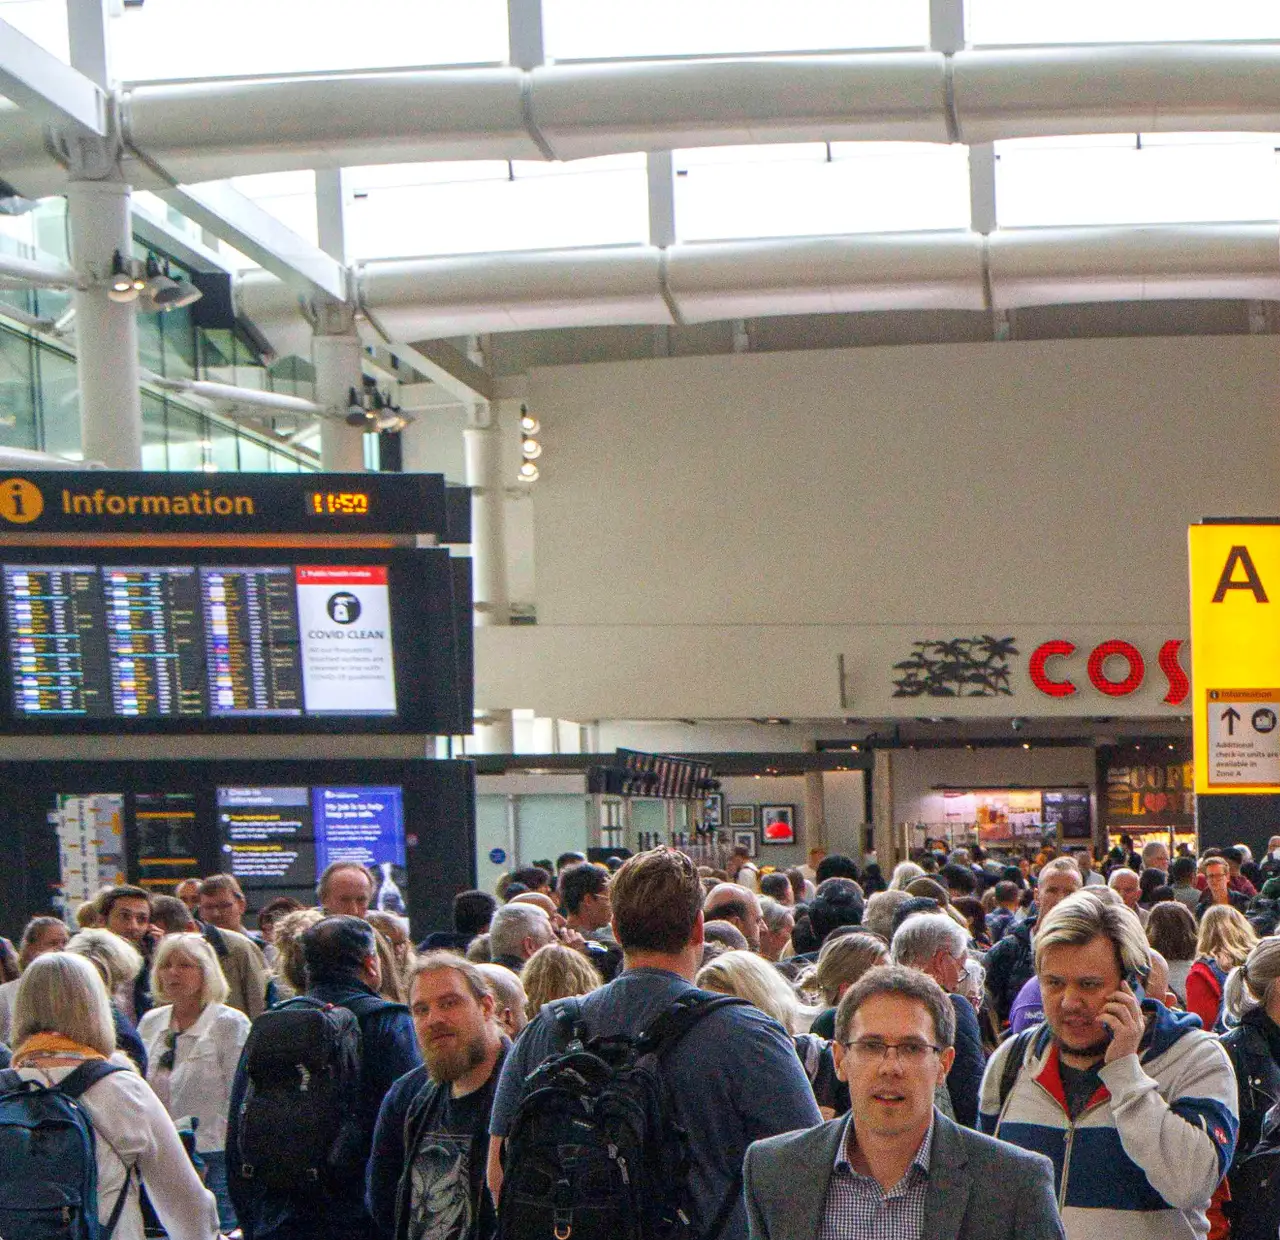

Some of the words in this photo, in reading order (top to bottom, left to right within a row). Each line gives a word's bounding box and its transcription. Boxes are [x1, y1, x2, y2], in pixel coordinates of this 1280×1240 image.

[62, 489, 255, 516] Information
[1211, 545, 1270, 604] A
[307, 630, 345, 640] COVID
[347, 630, 385, 640] CLEAN
